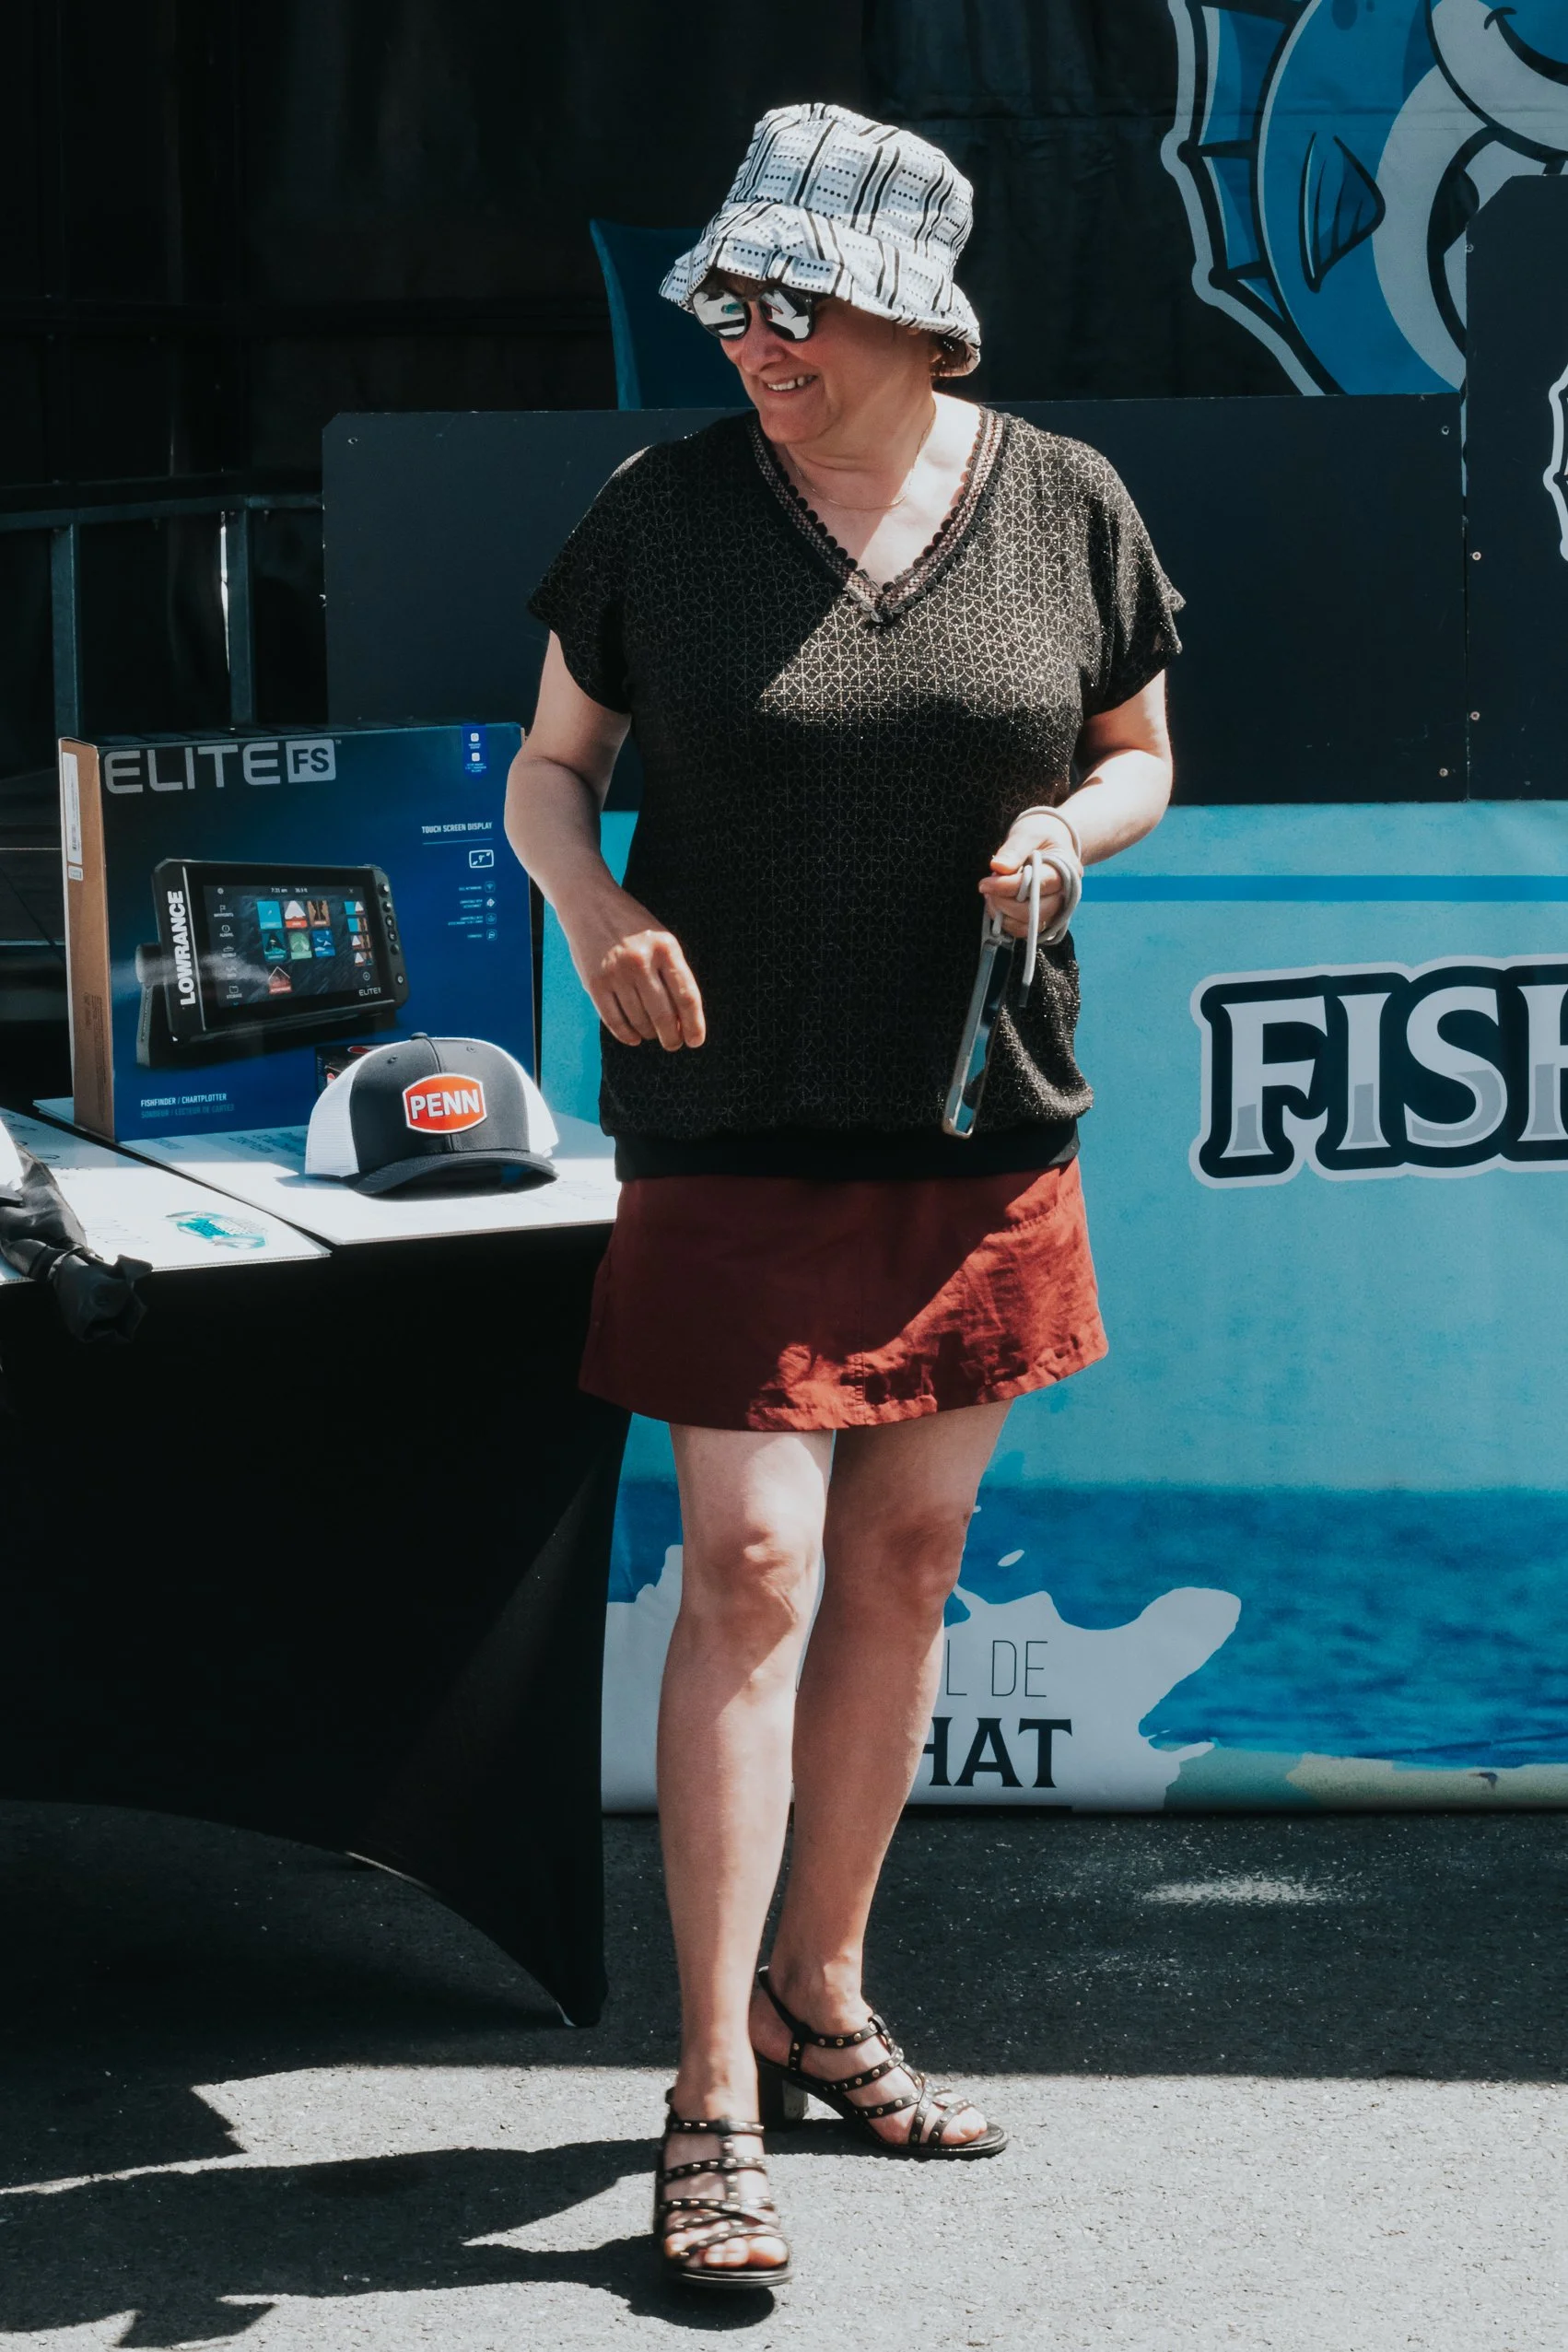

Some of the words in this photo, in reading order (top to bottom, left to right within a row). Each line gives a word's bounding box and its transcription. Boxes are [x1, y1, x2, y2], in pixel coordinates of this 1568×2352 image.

[104, 742, 281, 794] ELITE
[291, 745, 332, 778] FS
[421, 825, 441, 834] TOUCH
[442, 824, 466, 833] SCREEN
[468, 822, 493, 831] DISPLAY
[168, 890, 196, 1005] LOWRANCE
[140, 1096, 177, 1107] FISHFINDER
[181, 1093, 228, 1105] CHARTPLOTTER
[409, 1088, 481, 1120] PENN
[991, 1640, 1048, 1697] DE
